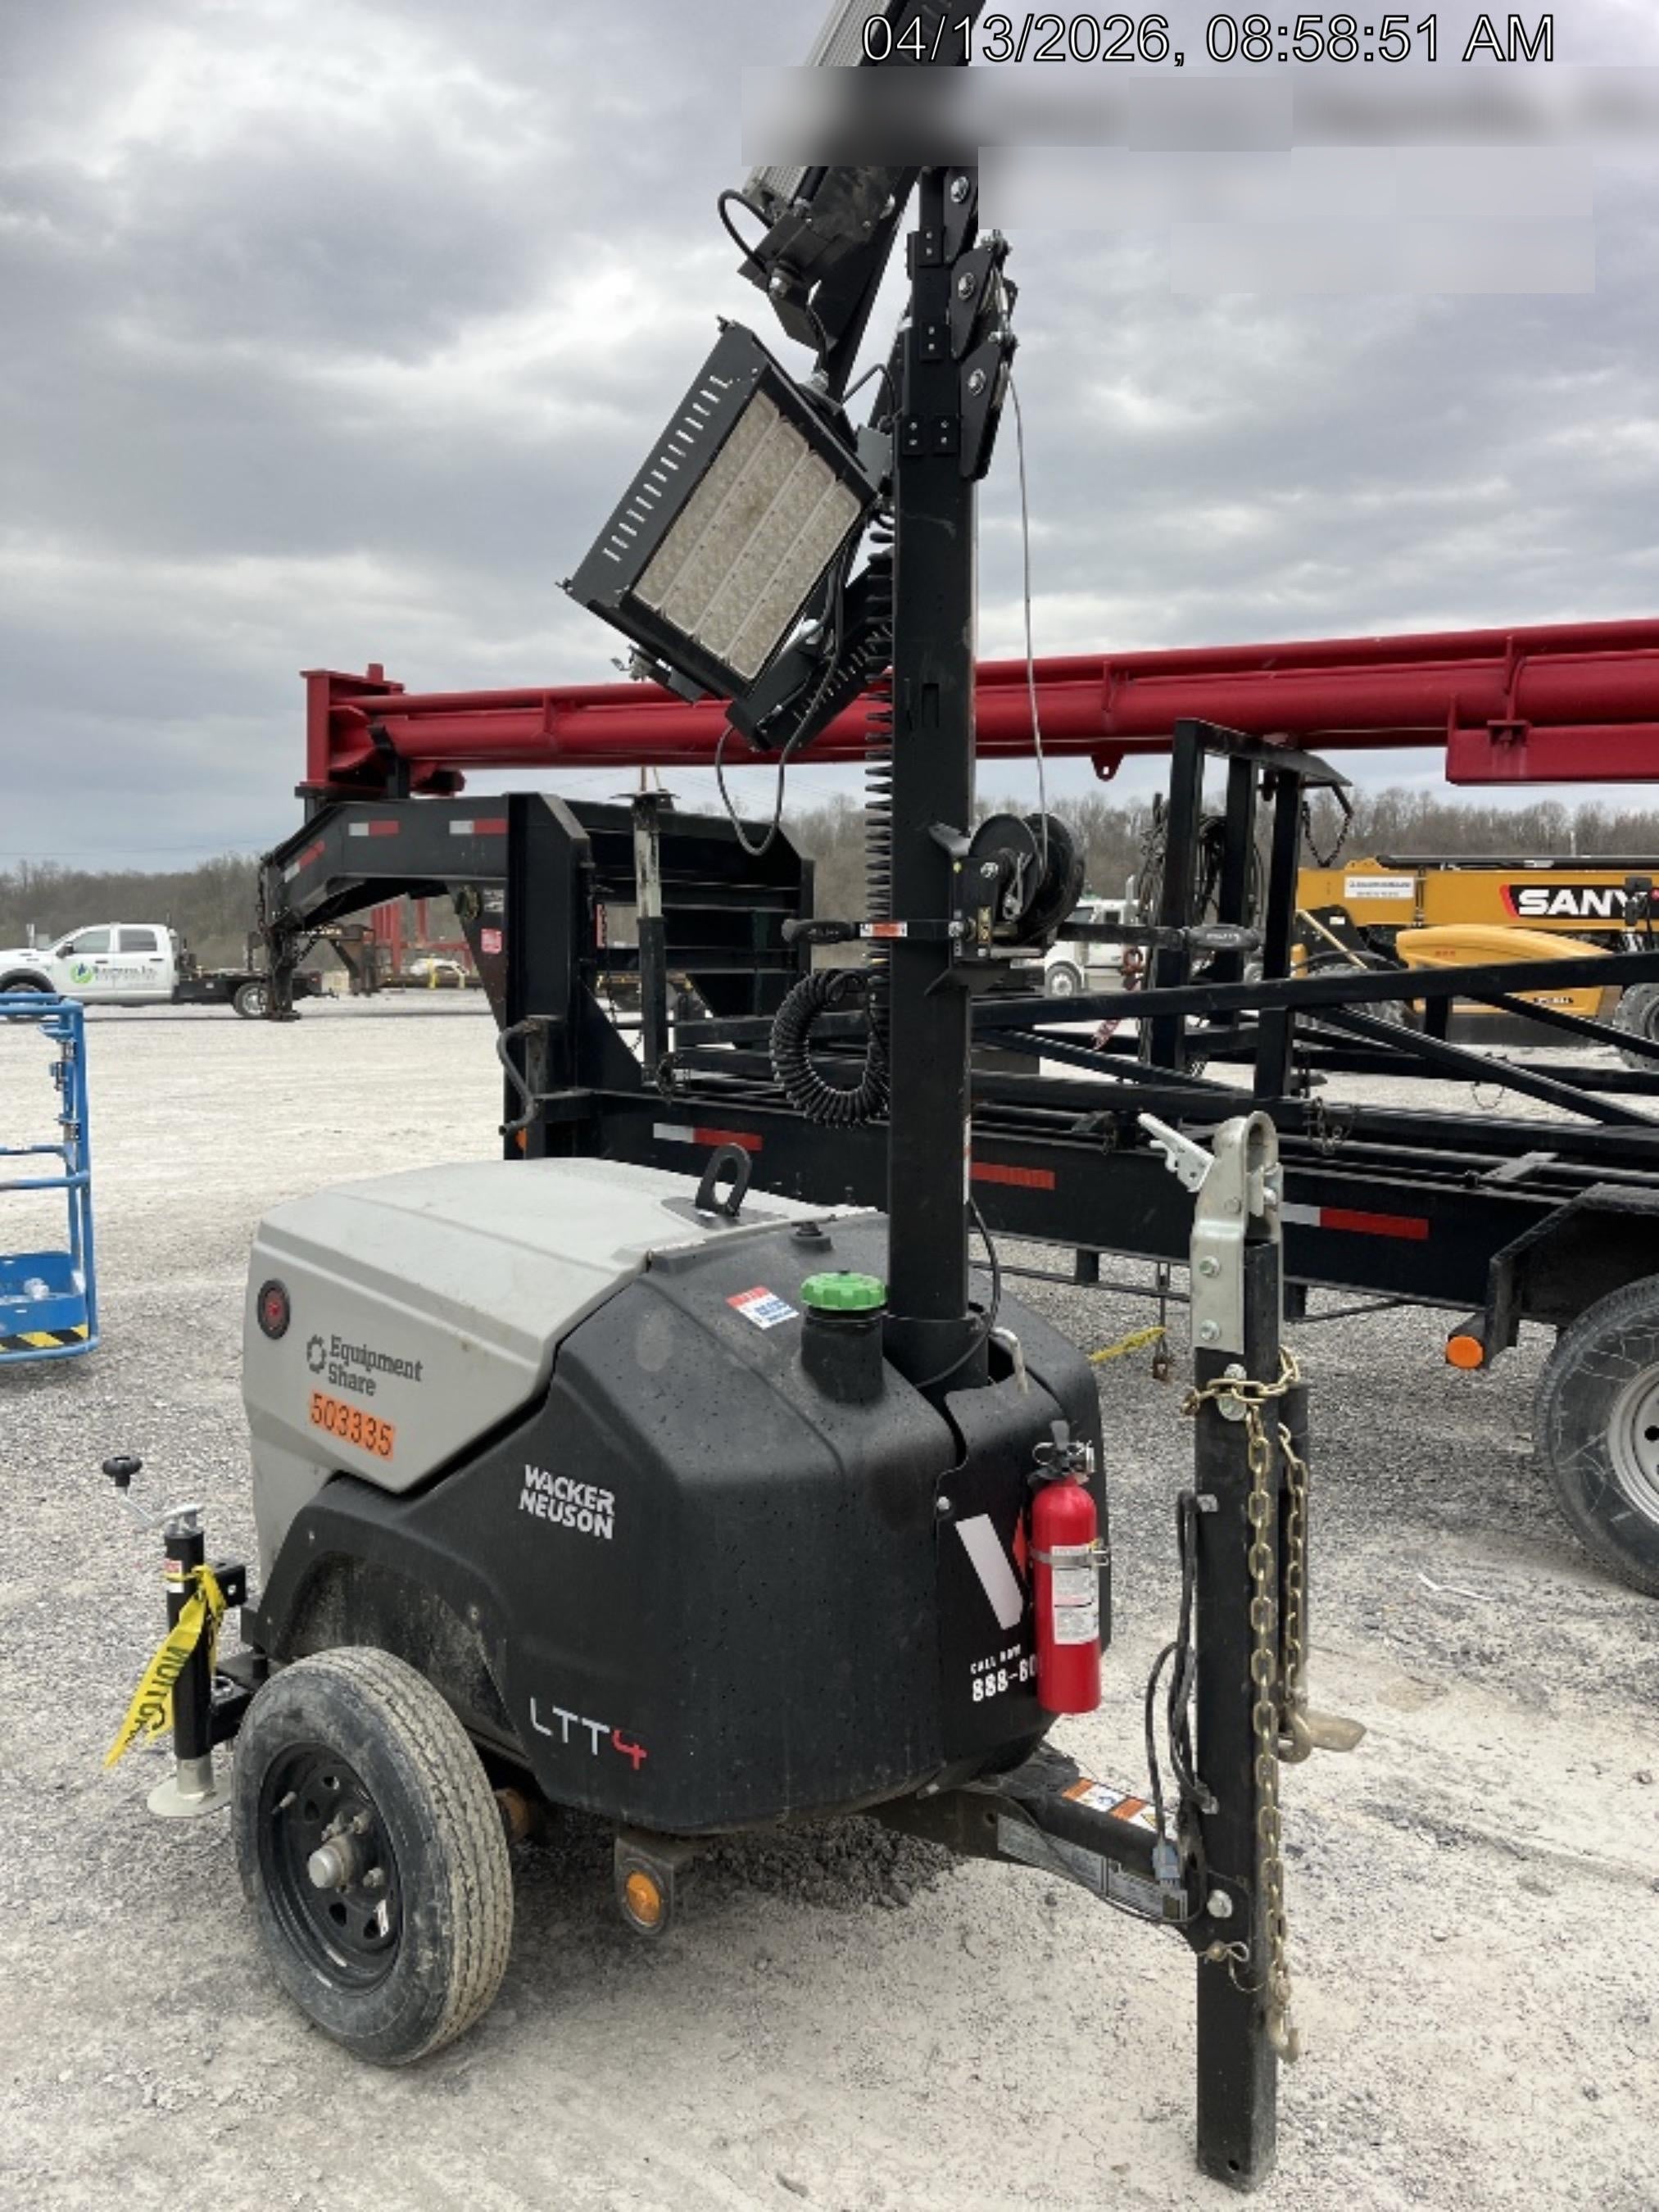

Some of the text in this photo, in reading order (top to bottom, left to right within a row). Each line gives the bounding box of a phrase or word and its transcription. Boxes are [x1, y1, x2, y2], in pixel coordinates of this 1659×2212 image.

[329, 1334, 424, 1382] Equipment
[329, 1362, 377, 1397] Share
[311, 1393, 392, 1456] 503335
[518, 1489, 613, 1540] NEUSON
[524, 1464, 615, 1517] WACKER
[529, 1697, 647, 1770] LTT4
